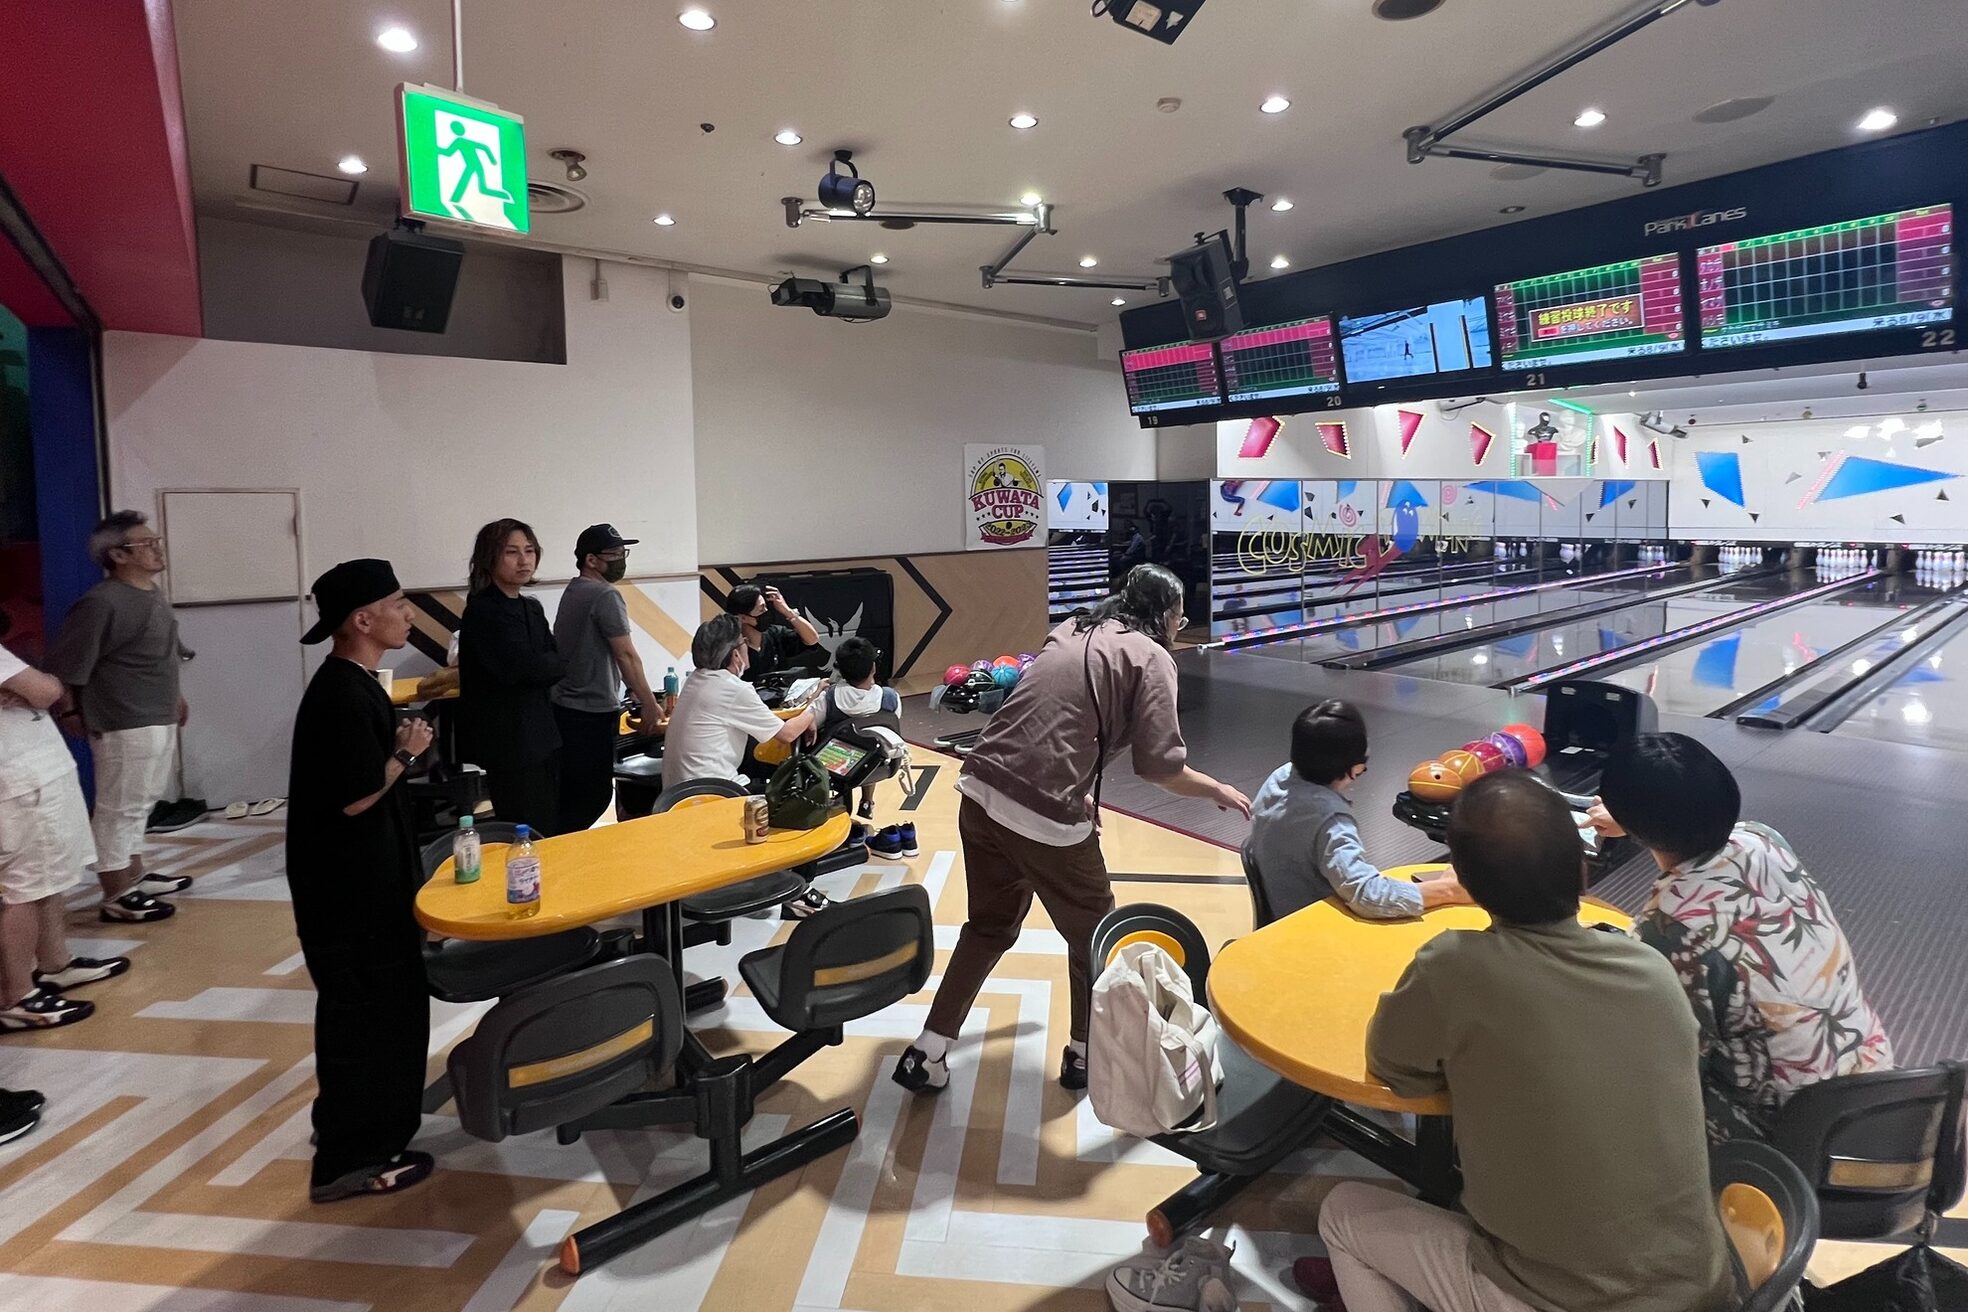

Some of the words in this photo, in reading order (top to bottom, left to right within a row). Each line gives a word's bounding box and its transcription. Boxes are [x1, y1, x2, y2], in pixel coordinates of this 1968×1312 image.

[1922, 329, 1956, 348] 22
[1526, 373, 1546, 387] 21
[1327, 395, 1342, 407] 20
[1147, 416, 1158, 425] 19
[971, 490, 1040, 512] KUWATA
[992, 504, 1024, 519] CUP
